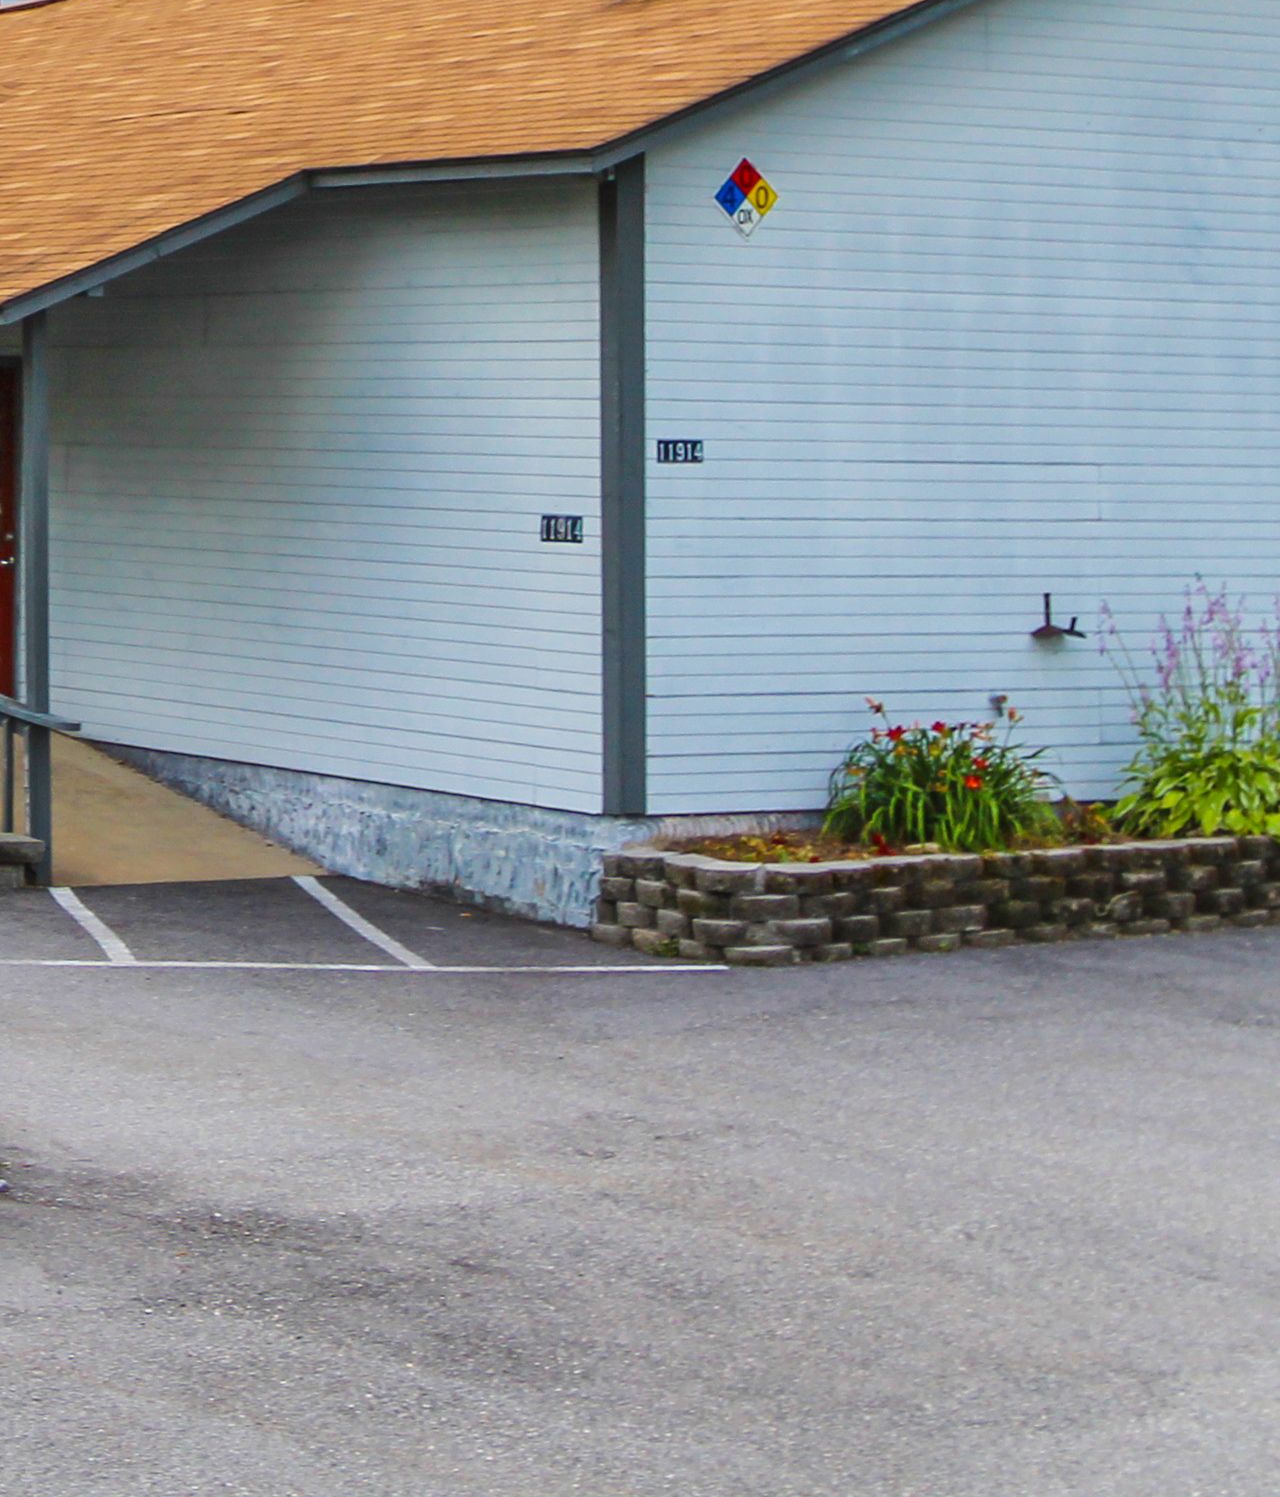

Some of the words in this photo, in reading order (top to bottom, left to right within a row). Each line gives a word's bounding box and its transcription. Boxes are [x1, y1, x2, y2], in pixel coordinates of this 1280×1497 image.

[740, 165, 755, 189] 0
[723, 185, 738, 206] 4
[755, 186, 769, 209] 0
[659, 442, 703, 461] 11914
